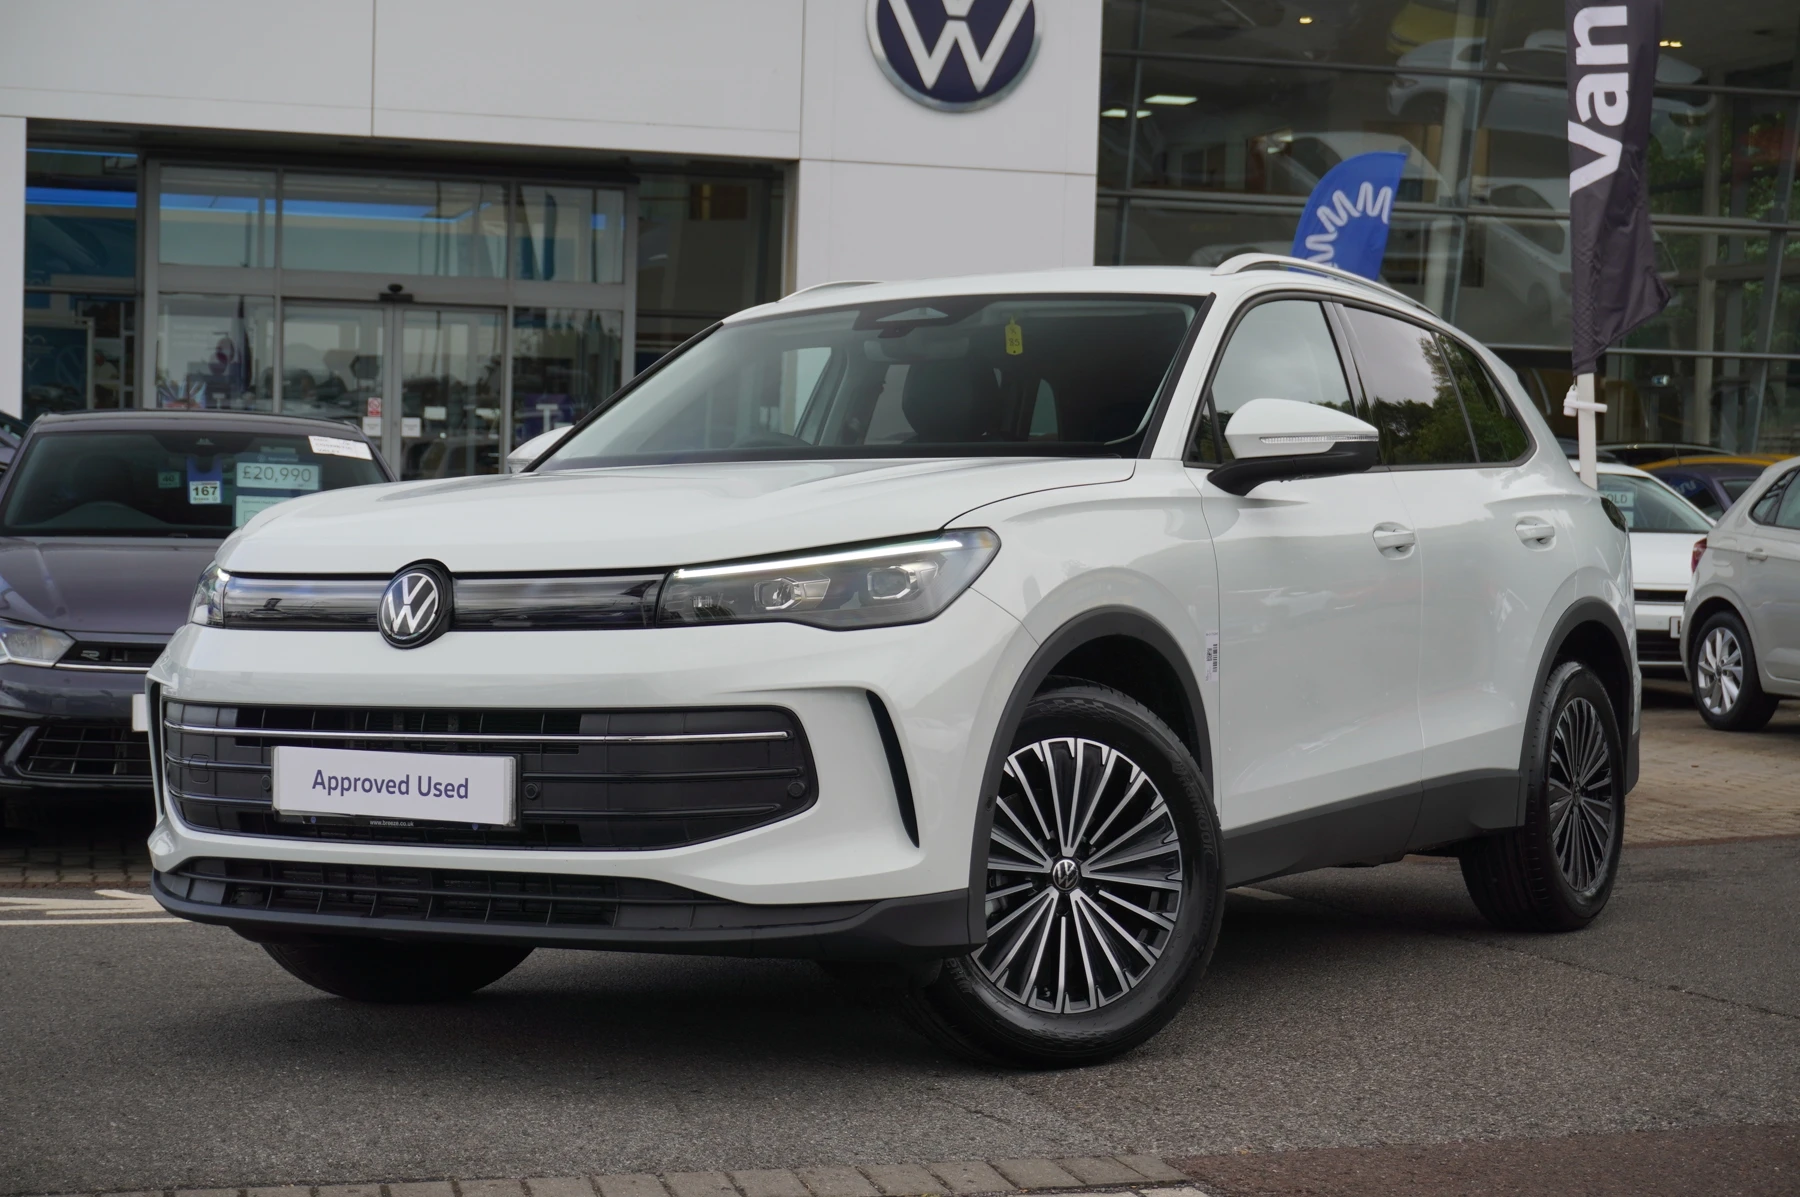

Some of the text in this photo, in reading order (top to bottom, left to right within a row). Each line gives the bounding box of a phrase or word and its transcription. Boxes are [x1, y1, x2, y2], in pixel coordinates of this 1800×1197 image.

[887, 0, 1032, 93] W
[242, 465, 312, 483] £20,990
[192, 486, 218, 496] 167
[1602, 493, 1627, 504] OLD
[312, 769, 469, 799] Approved Used
